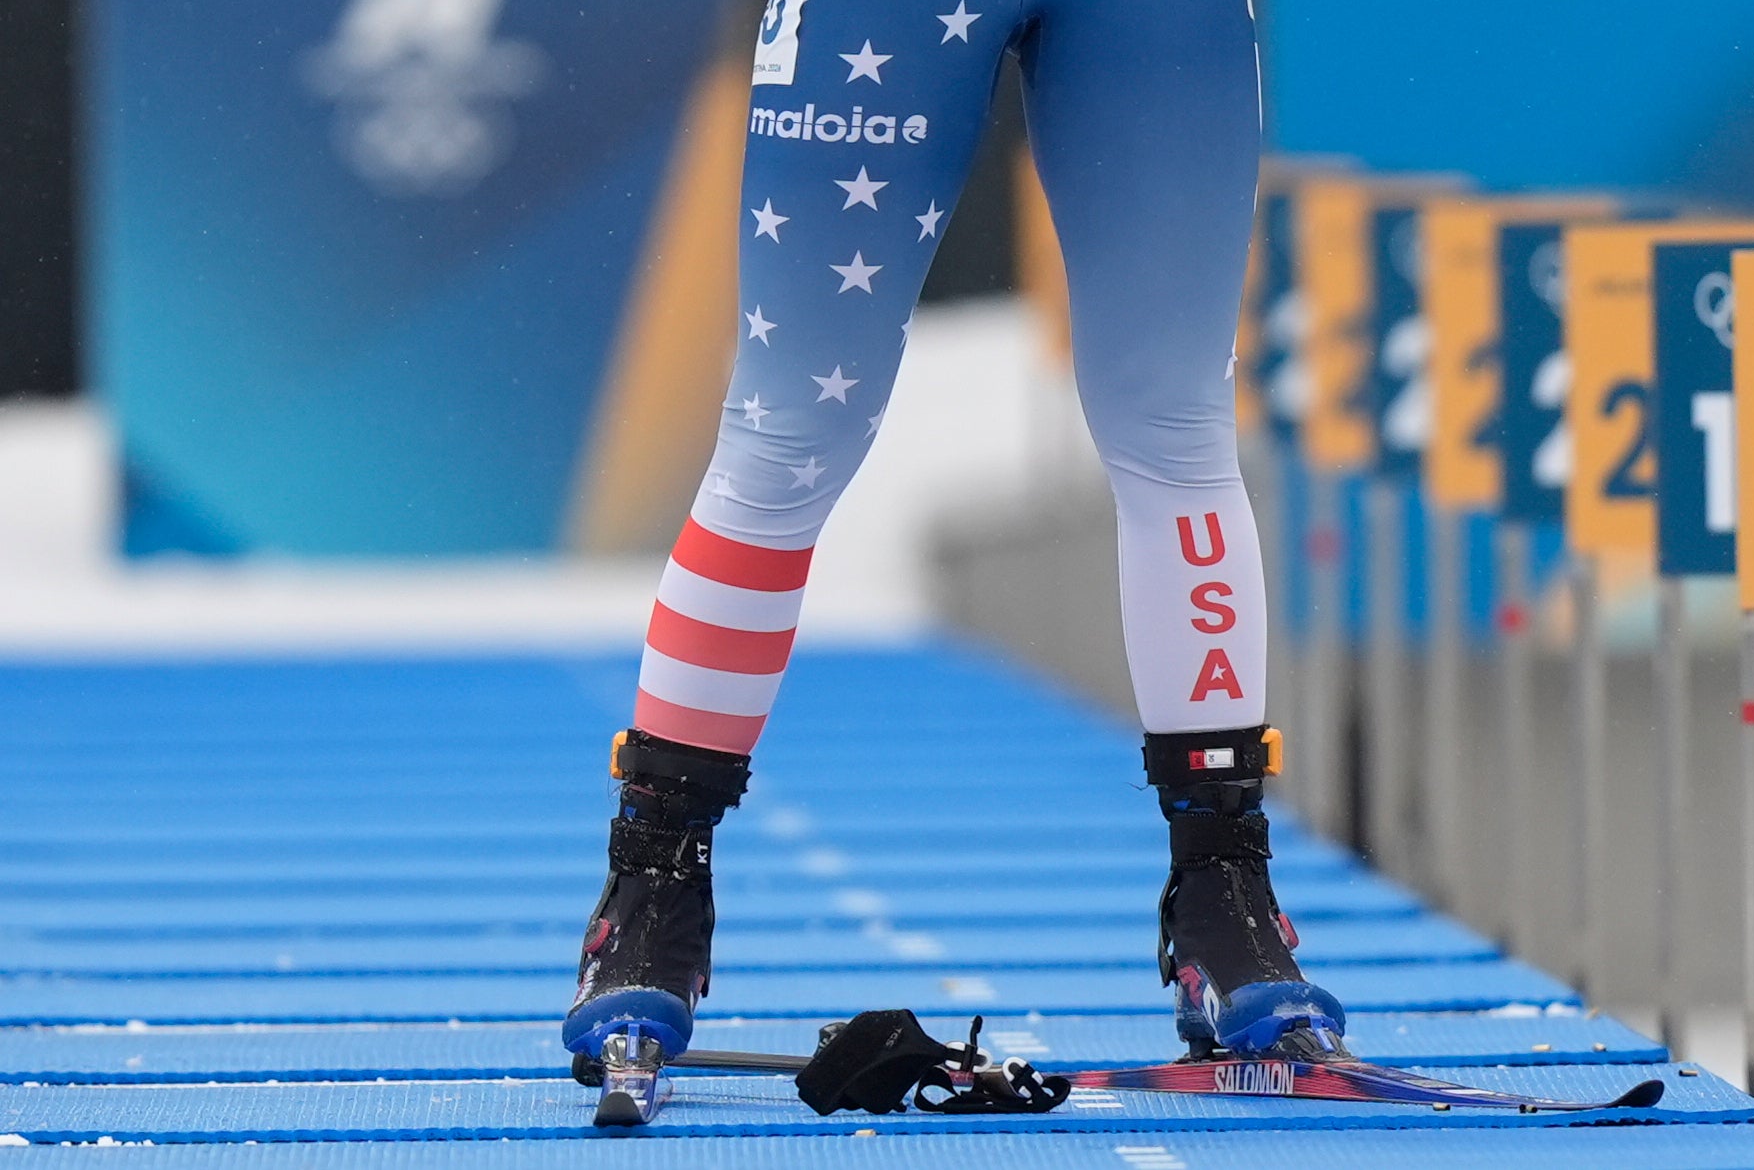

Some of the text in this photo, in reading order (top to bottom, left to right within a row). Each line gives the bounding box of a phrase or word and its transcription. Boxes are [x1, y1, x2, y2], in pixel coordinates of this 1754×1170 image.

[751, 103, 896, 144] maloja
[1602, 382, 1656, 499] 2
[1692, 392, 1737, 531] 1
[1176, 512, 1244, 701] USA
[1213, 1063, 1295, 1094] SALOMON
